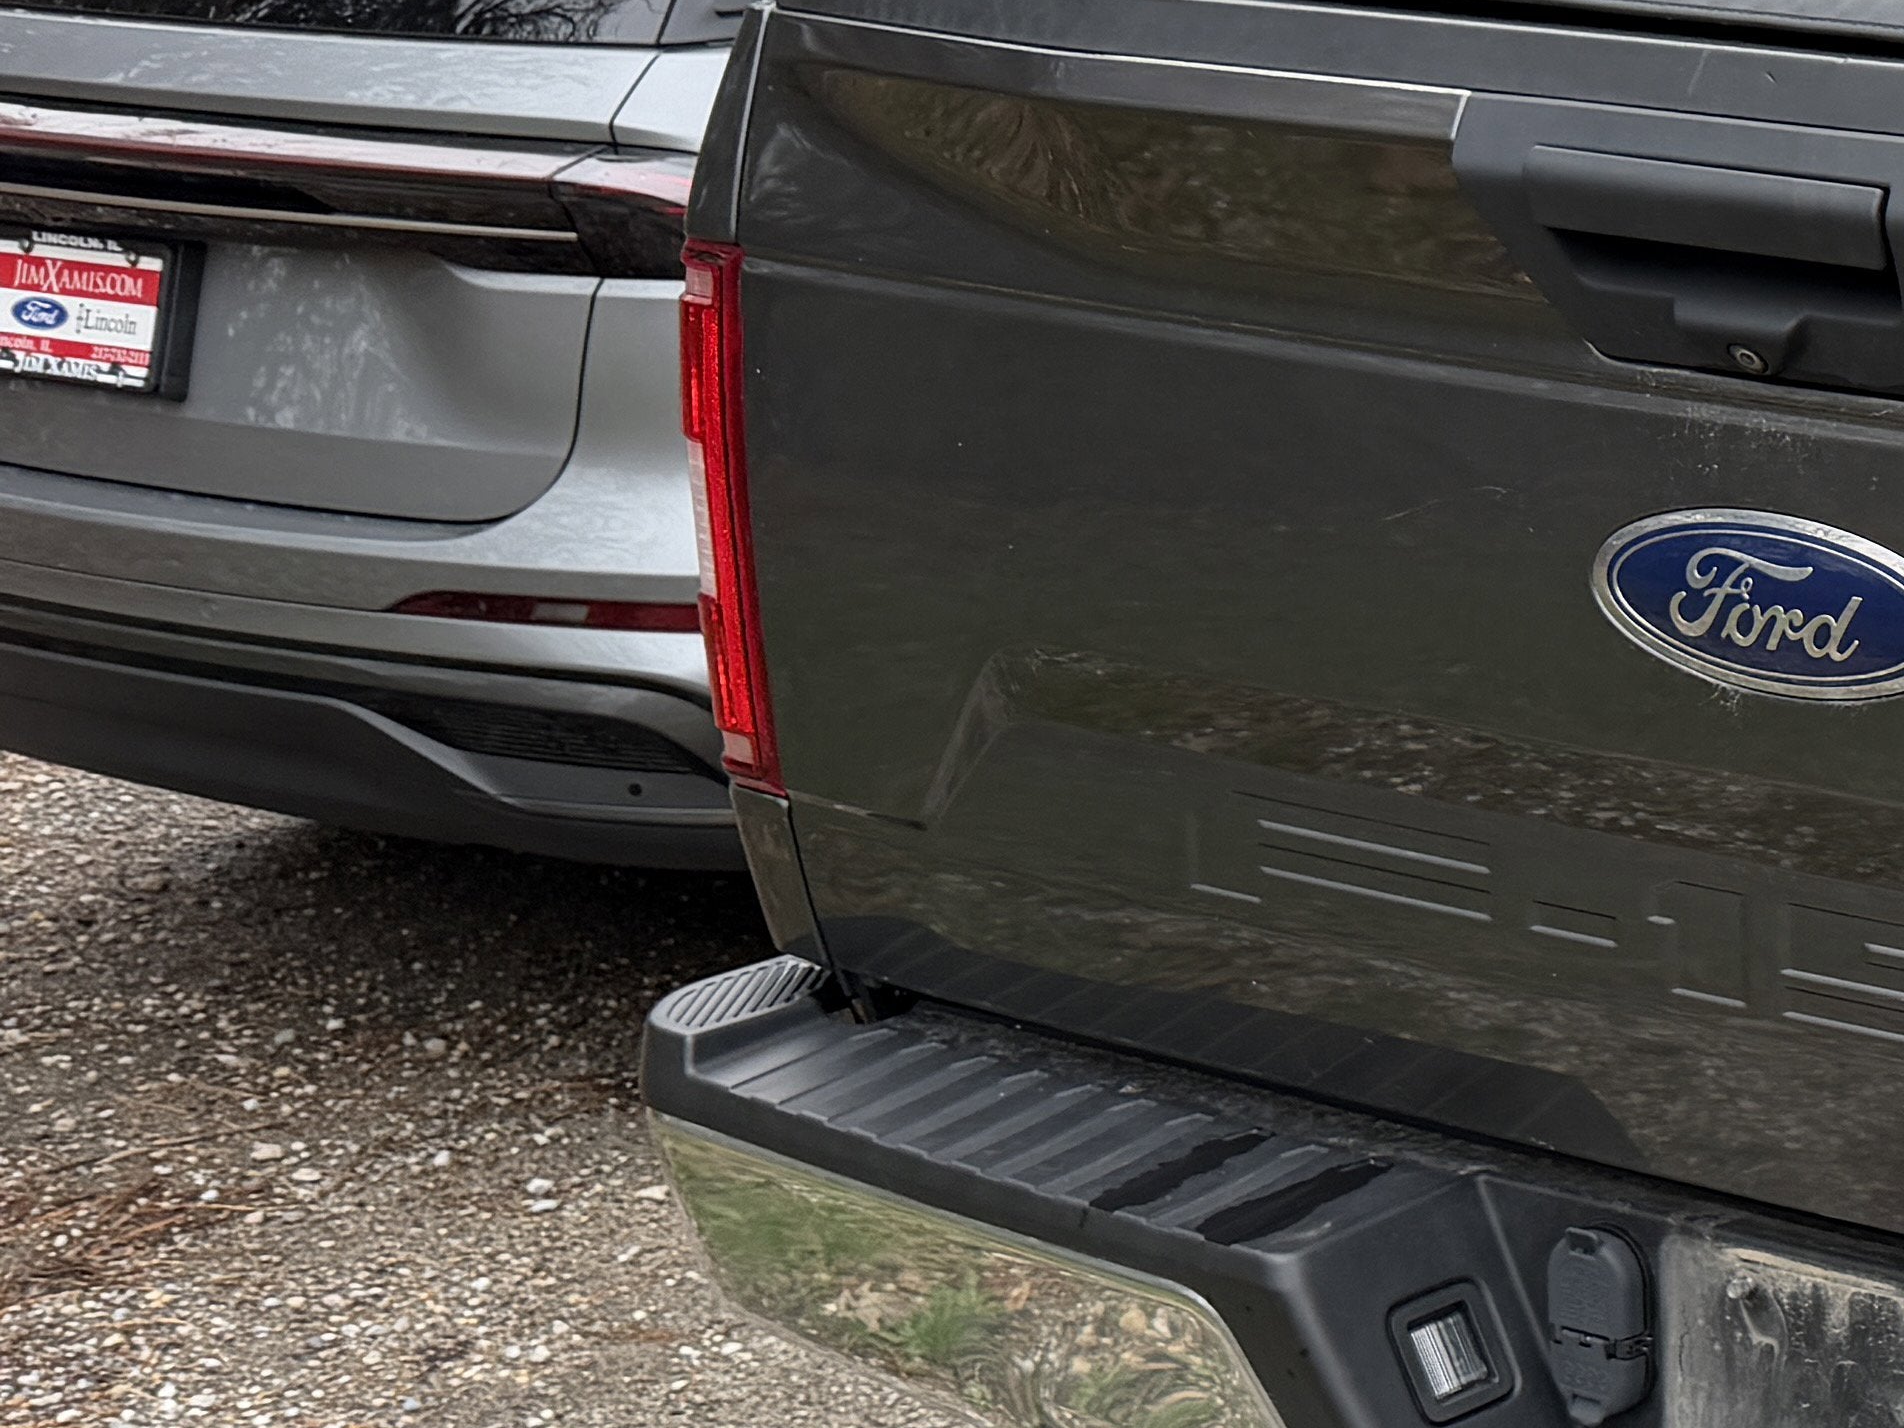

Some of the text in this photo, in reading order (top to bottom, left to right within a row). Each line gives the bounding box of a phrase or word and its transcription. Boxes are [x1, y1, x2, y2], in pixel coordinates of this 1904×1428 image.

[20, 300, 61, 325] Ford
[84, 309, 137, 335] Lincoln
[1669, 547, 1864, 663] Ford
